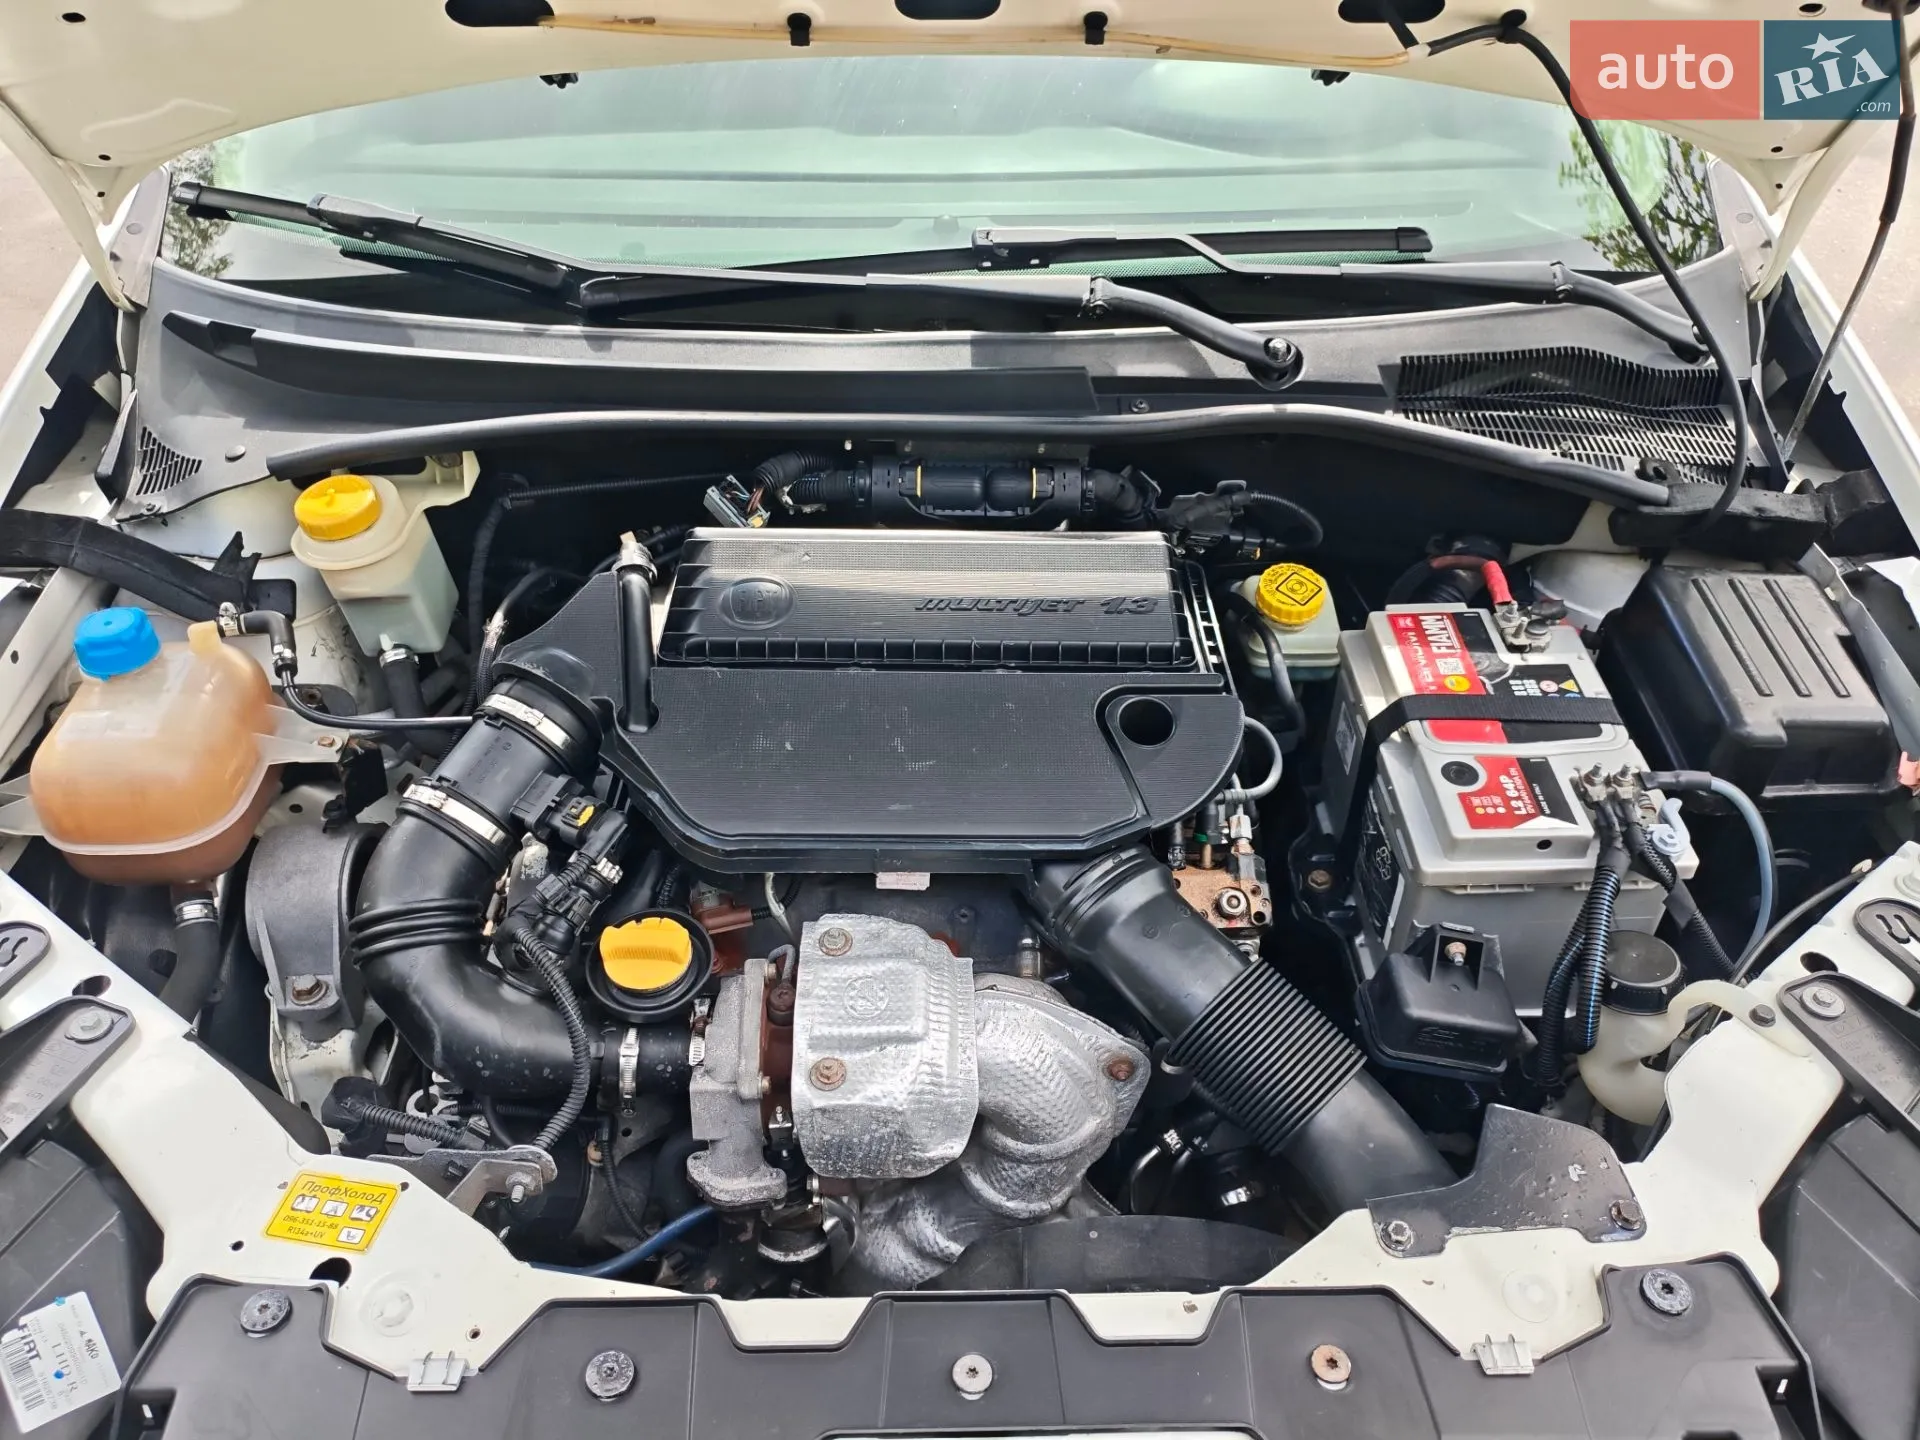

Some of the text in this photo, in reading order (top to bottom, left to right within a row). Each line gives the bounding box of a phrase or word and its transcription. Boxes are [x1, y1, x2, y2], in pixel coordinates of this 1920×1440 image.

[1100, 596, 1159, 615] 1.3
[1418, 615, 1462, 653] FIAMM
[1498, 774, 1527, 815] L2 64P
[17, 1322, 42, 1362] FIAT
